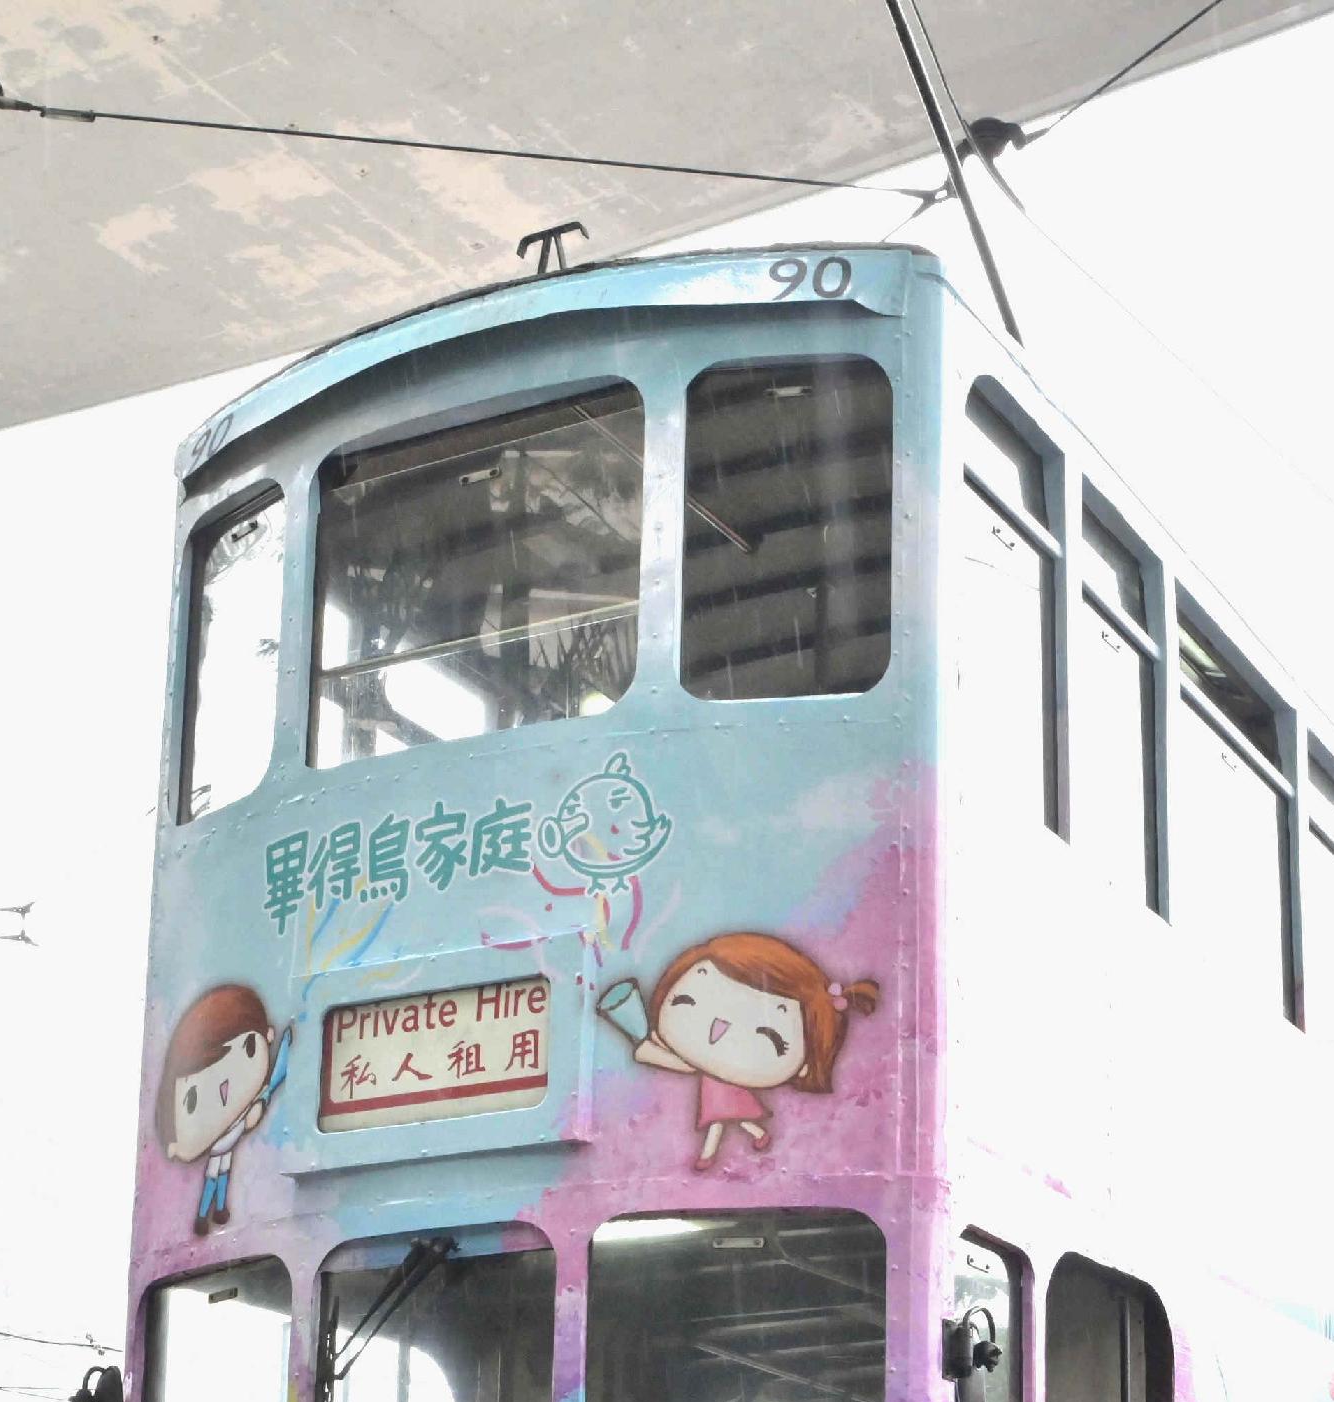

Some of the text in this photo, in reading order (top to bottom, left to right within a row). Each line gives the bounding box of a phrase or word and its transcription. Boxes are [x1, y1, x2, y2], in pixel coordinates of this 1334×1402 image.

[769, 256, 852, 301] 90
[188, 413, 234, 473] 90
[263, 798, 533, 936] 畢得鳥家庭
[336, 982, 548, 1043] Private Hire
[340, 1028, 540, 1100] 私人租用
